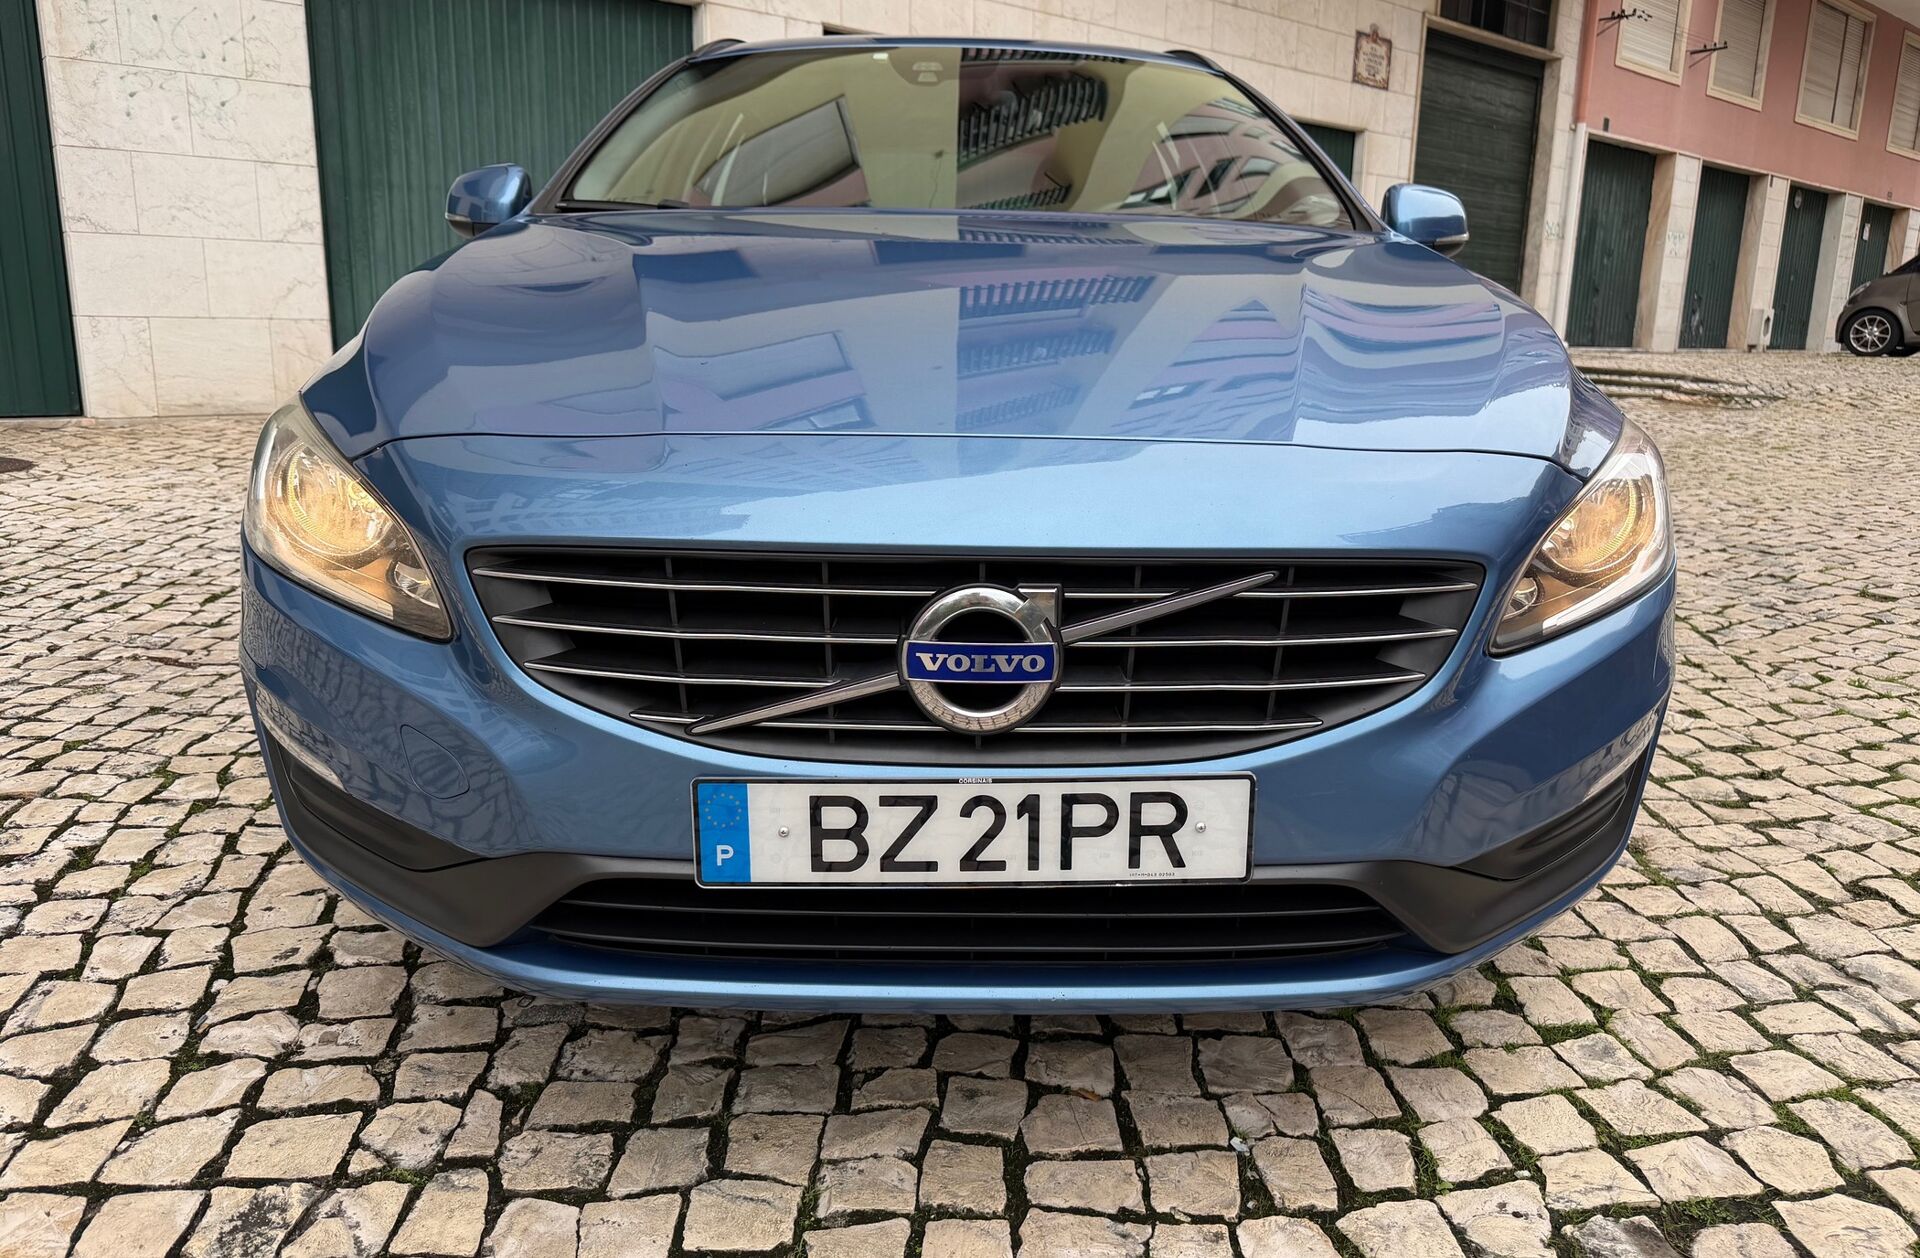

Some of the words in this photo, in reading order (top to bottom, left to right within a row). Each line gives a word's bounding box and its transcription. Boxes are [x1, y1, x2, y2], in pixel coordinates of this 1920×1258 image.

[915, 652, 1046, 672] VOLVO
[809, 795, 939, 873] BZ
[959, 793, 1040, 871] 21
[1060, 791, 1188, 870] PR
[716, 845, 734, 866] P
